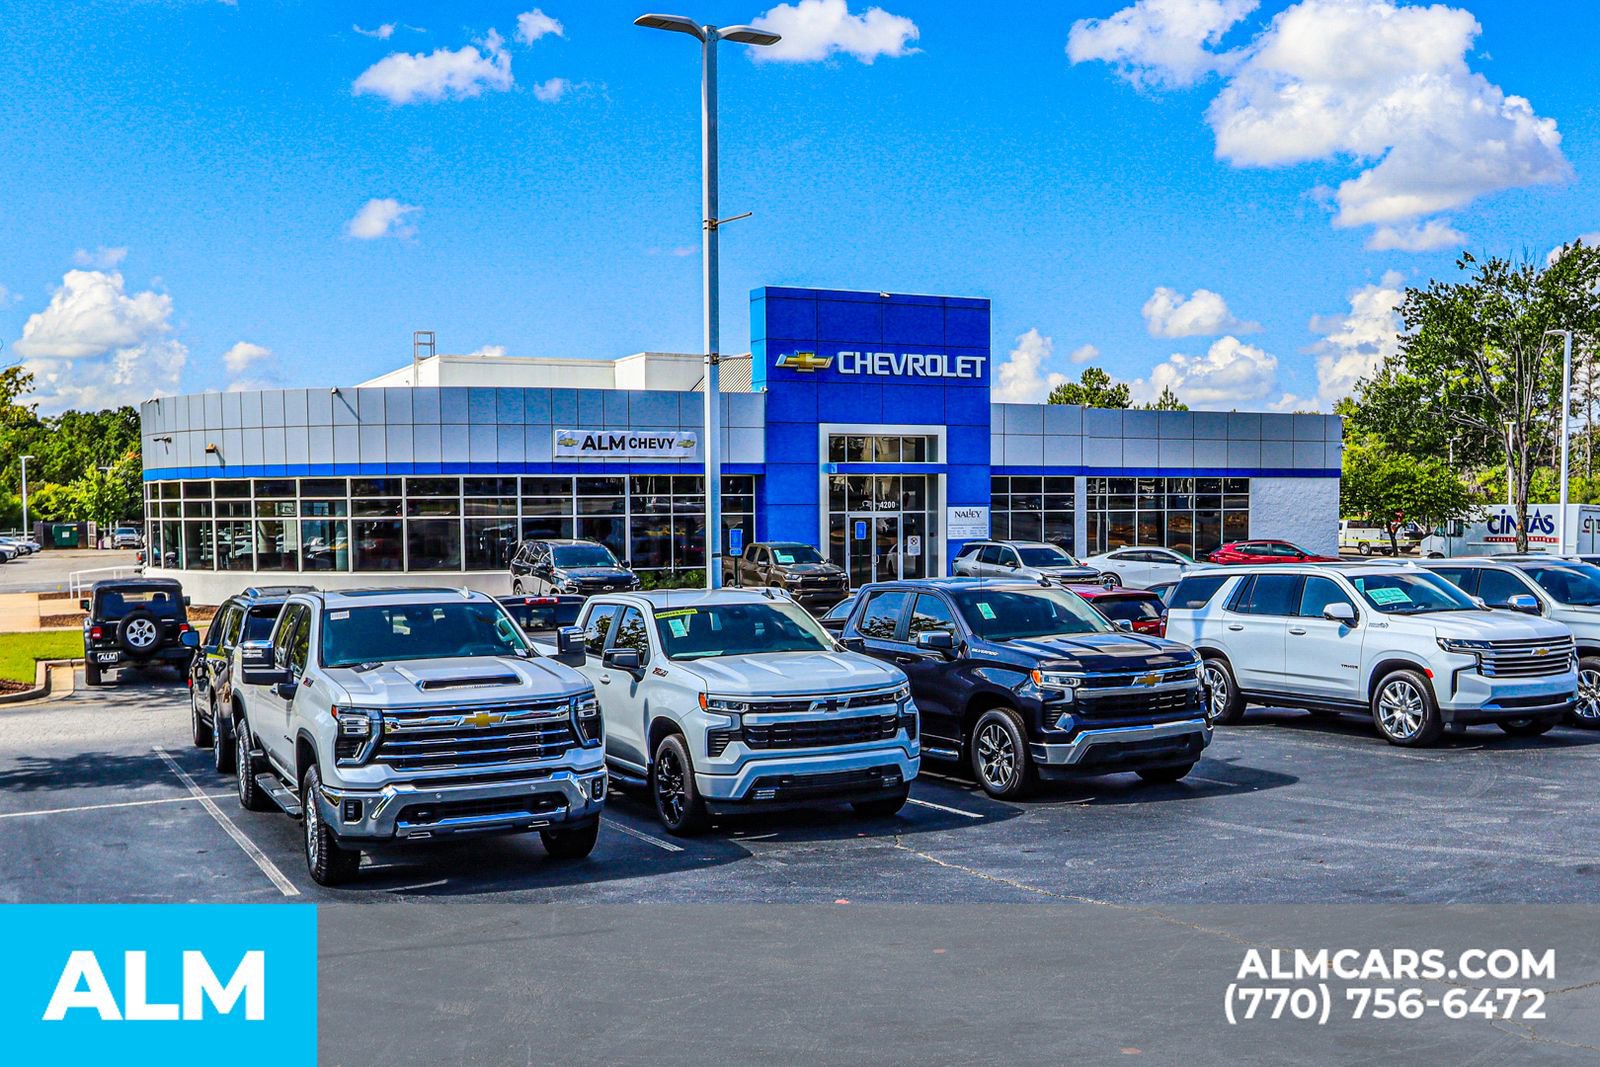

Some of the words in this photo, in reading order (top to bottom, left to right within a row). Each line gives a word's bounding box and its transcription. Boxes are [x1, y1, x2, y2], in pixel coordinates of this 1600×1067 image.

[837, 351, 986, 378] CHEVROLET
[581, 435, 626, 451] ALM
[628, 437, 675, 449] CHEVY
[879, 501, 896, 509] 4200
